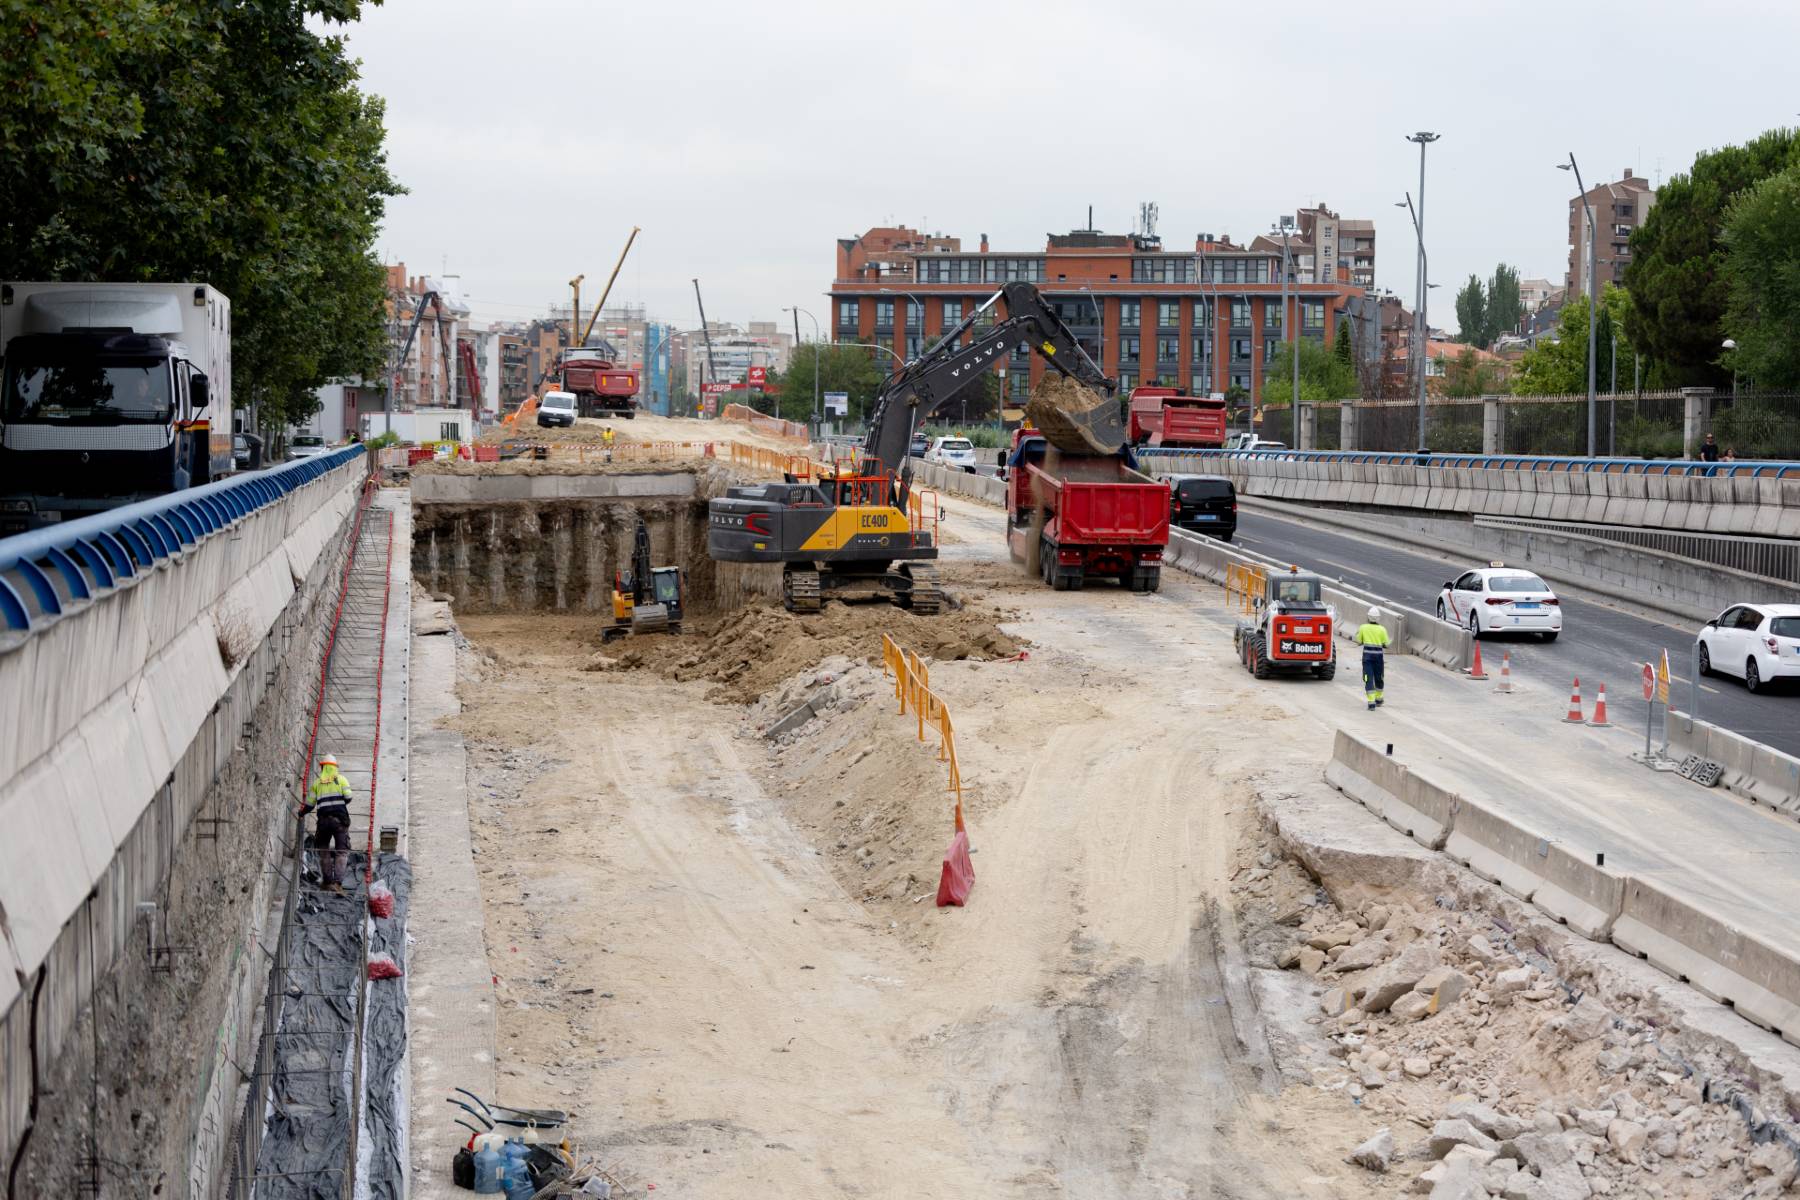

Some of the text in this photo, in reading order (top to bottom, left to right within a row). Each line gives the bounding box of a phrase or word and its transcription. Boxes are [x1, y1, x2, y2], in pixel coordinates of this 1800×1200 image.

[951, 341, 1004, 377] VOLVO
[861, 514, 888, 528] EC400
[1295, 643, 1323, 653] Bobcat
